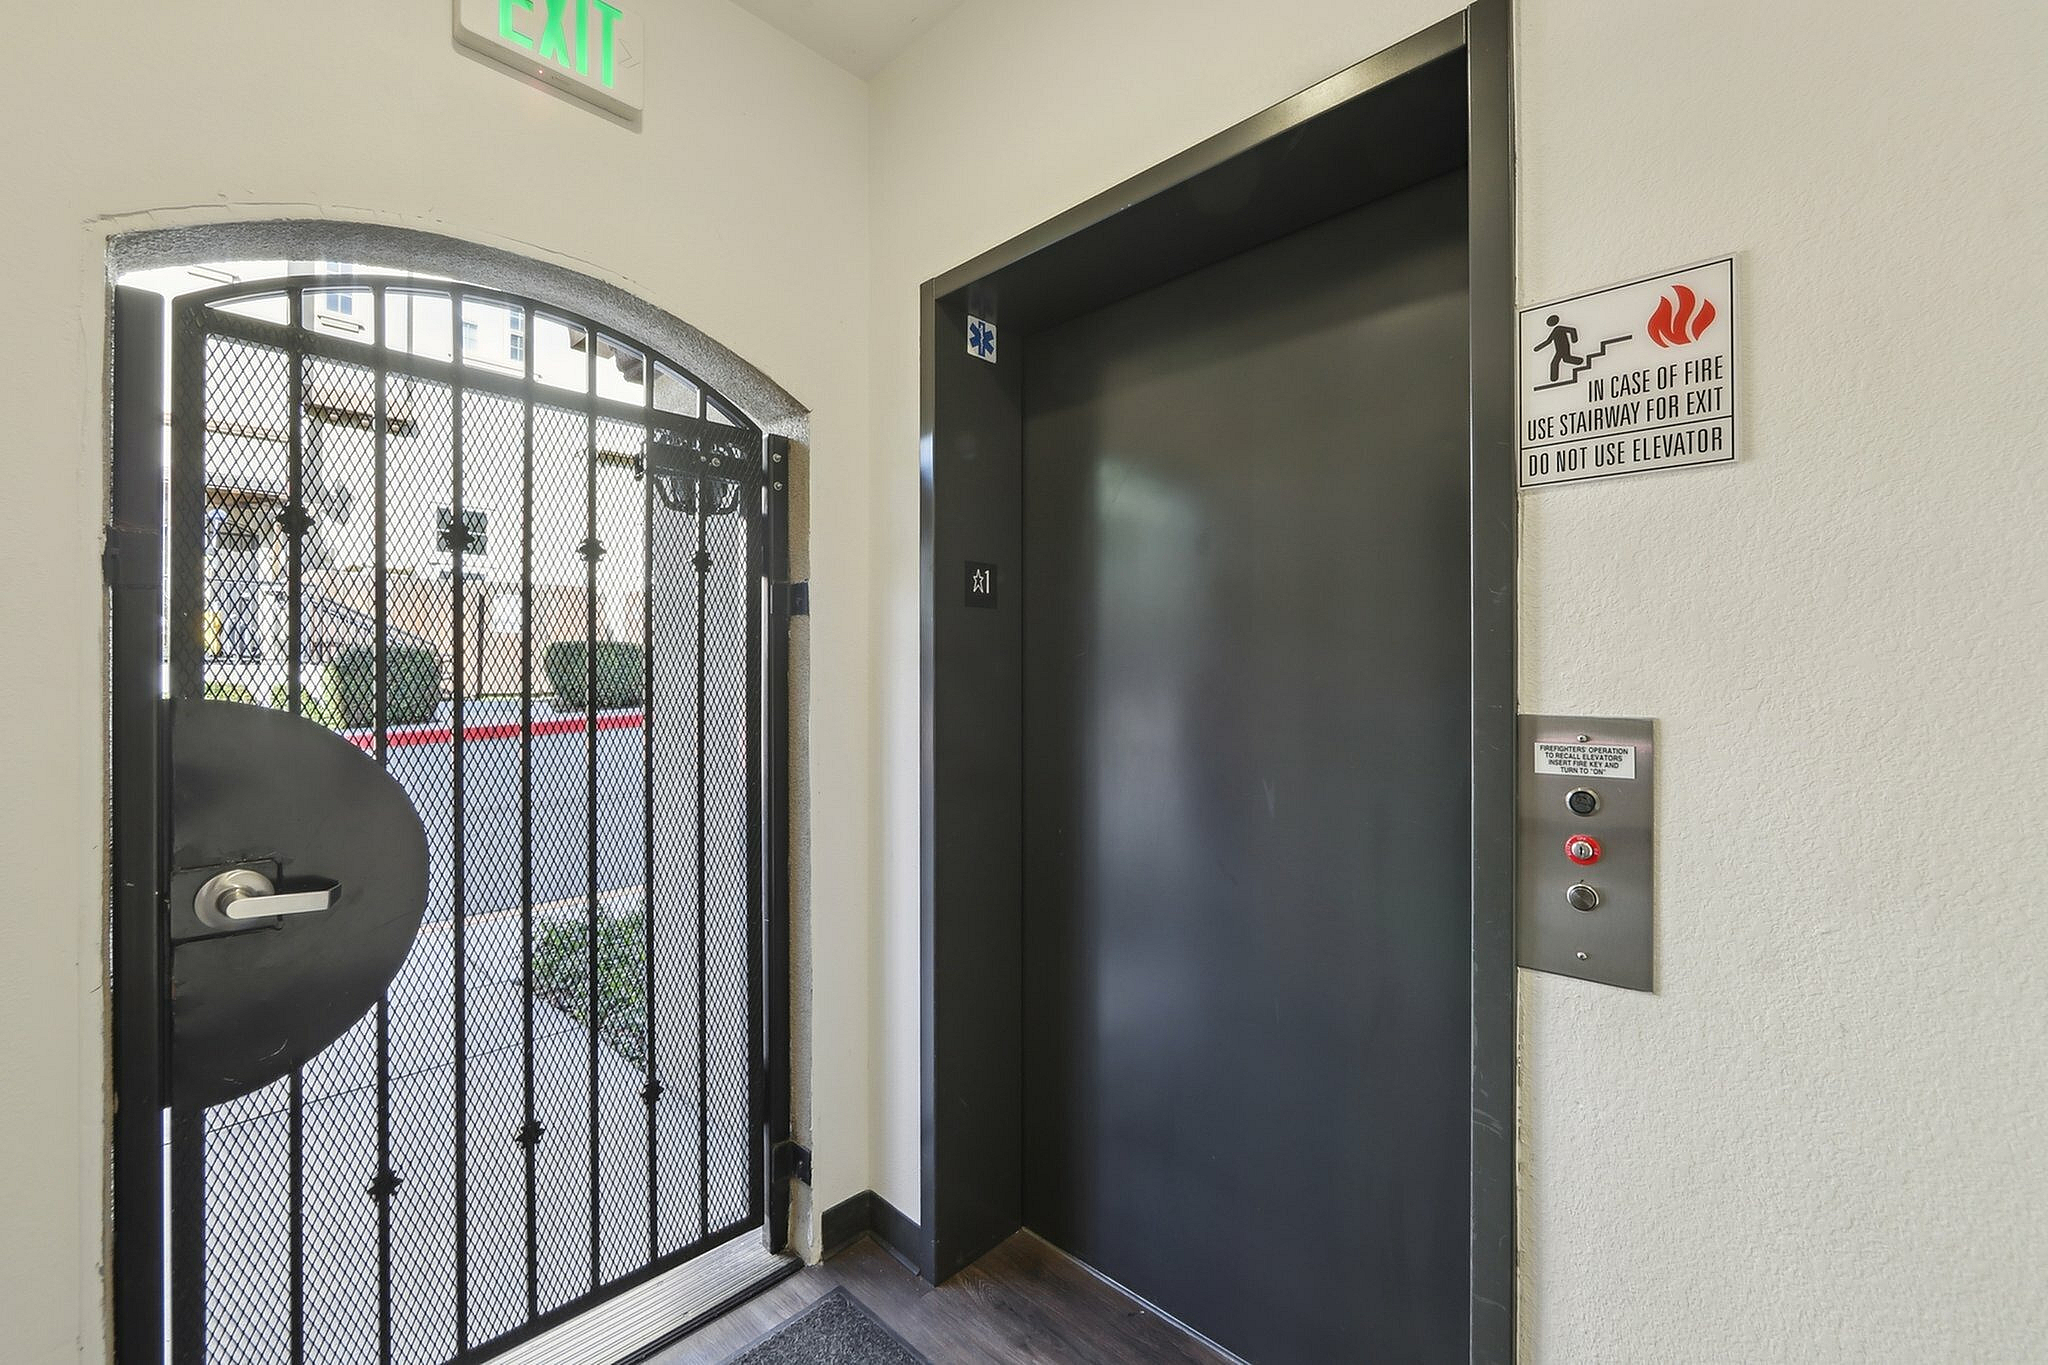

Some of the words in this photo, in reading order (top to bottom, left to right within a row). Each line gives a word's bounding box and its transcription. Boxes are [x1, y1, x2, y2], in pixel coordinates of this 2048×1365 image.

[1588, 379, 1604, 402] IN
[1610, 369, 1651, 398] CASE
[1657, 364, 1678, 390] OF
[1685, 355, 1724, 385] FIRE
[1527, 416, 1554, 441] USE
[1559, 401, 1641, 436] STAIRWAY
[1646, 394, 1679, 422] FOR
[1686, 387, 1723, 415] EXIT
[1529, 453, 1549, 477] DO
[1556, 446, 1588, 473] NOT
[1595, 441, 1625, 468] USE
[1633, 426, 1723, 462] ELEVATOR
[1555, 752, 1581, 760] RECALL
[1588, 747, 1629, 755] OPERATION
